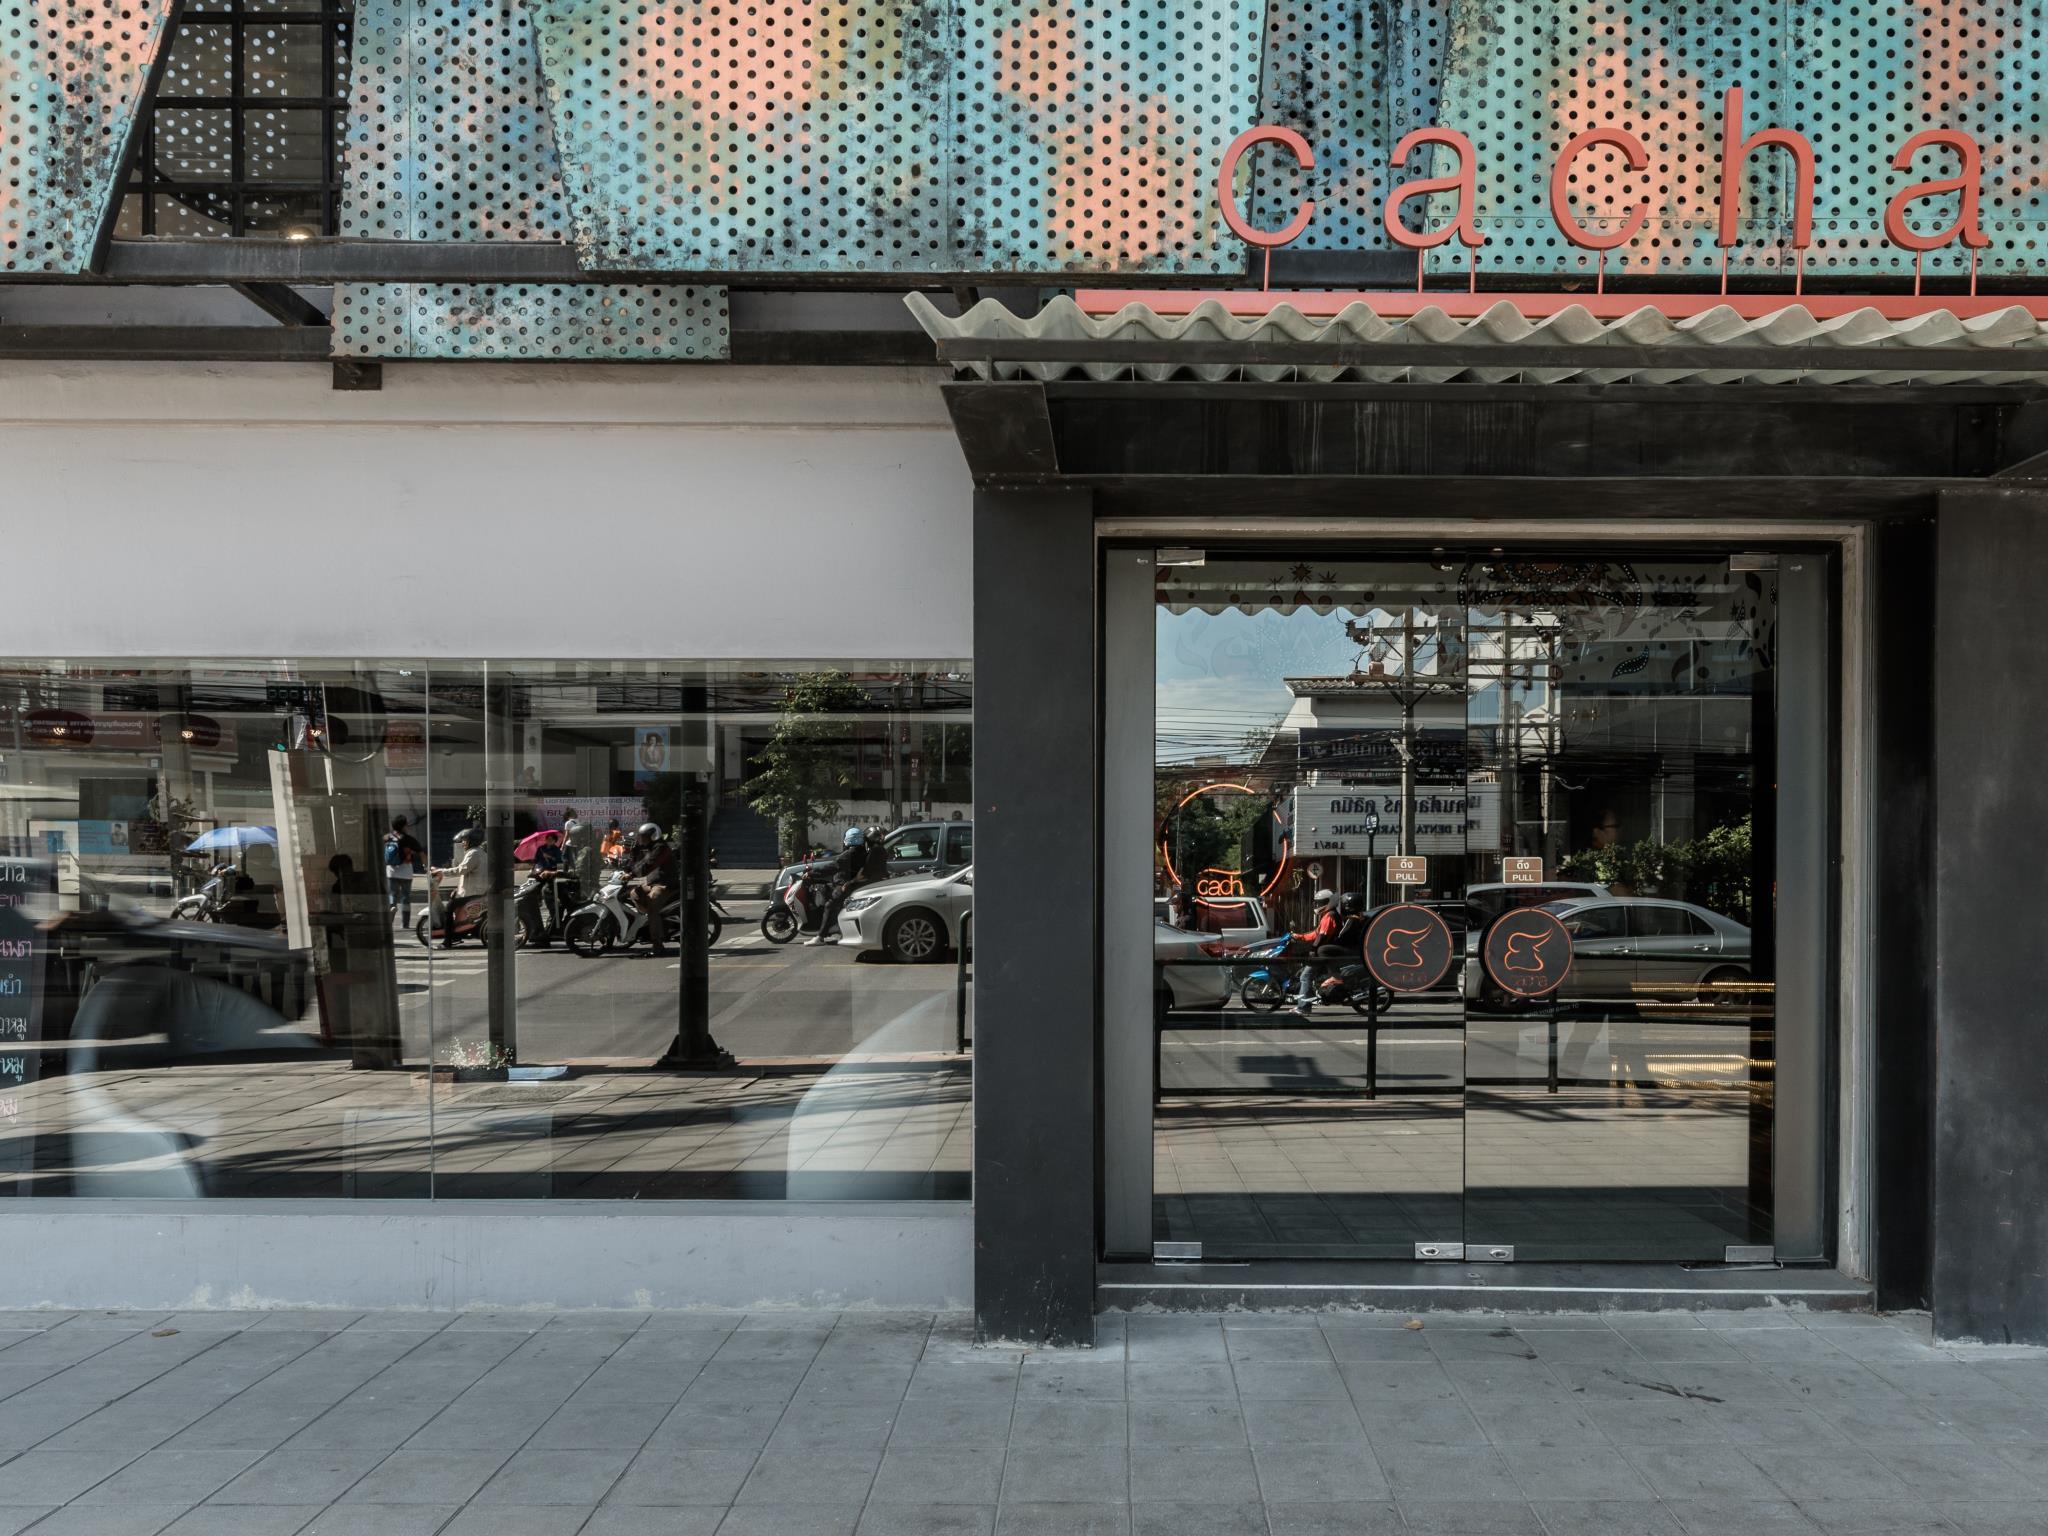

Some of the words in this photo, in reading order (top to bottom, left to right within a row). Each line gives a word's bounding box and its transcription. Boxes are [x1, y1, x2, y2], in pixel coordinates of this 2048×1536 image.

[1218, 88, 1989, 251] cacha
[1395, 873, 1418, 881] PULL
[1512, 874, 1535, 882] PULL
